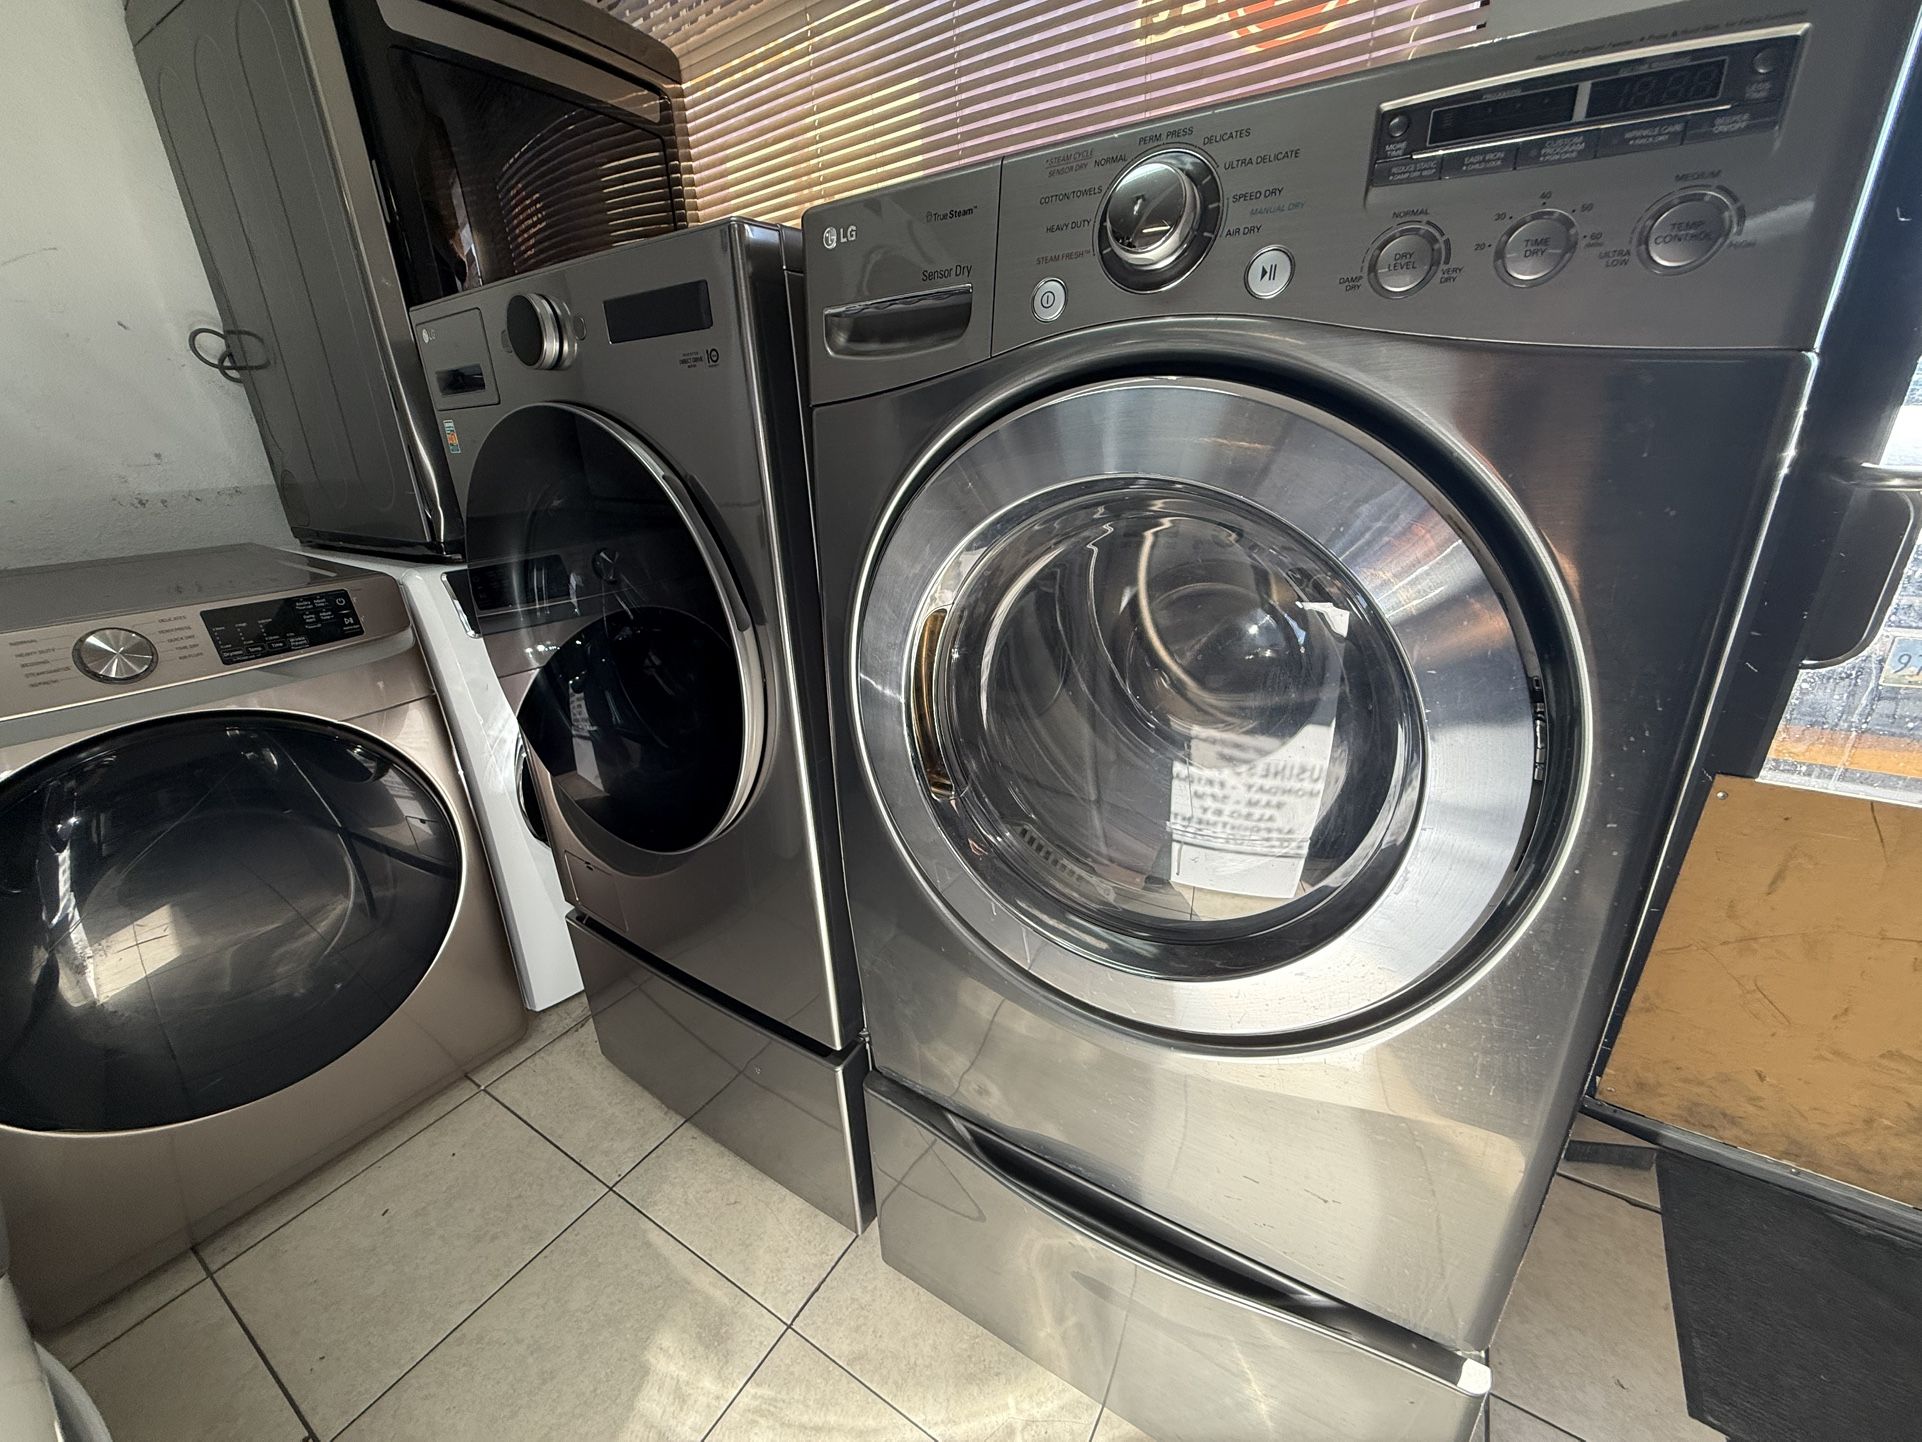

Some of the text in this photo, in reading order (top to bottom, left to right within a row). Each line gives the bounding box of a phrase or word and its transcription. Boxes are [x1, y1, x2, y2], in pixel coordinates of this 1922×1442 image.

[1166, 127, 1194, 141] PRESS
[1203, 128, 1252, 146] DELICATES
[1094, 154, 1128, 168] NORMAL
[1224, 149, 1301, 171] ULTRA DELICATE
[1232, 187, 1285, 204] SPEED DRY
[1539, 190, 1553, 200] 40
[1392, 208, 1430, 219] NORMAL
[1494, 211, 1507, 222] 30
[1046, 219, 1092, 234] HEAVY DUTY
[1225, 224, 1263, 238] AIR DRY
[840, 225, 857, 243] LG
[1590, 232, 1603, 241] 60
[1474, 242, 1486, 251] 20
[1524, 237, 1551, 248] TIME
[1394, 251, 1415, 261] DRY
[1523, 248, 1548, 258] DRY
[1036, 254, 1060, 265] STEAM
[1605, 258, 1630, 268] LOW
[1388, 261, 1417, 272] LEVEL
[1441, 265, 1464, 275] VERY
[922, 264, 973, 282] Sensor Dry
[1339, 275, 1363, 285] DAMP
[1440, 276, 1458, 285] DRY
[1345, 284, 1362, 292] DRY
